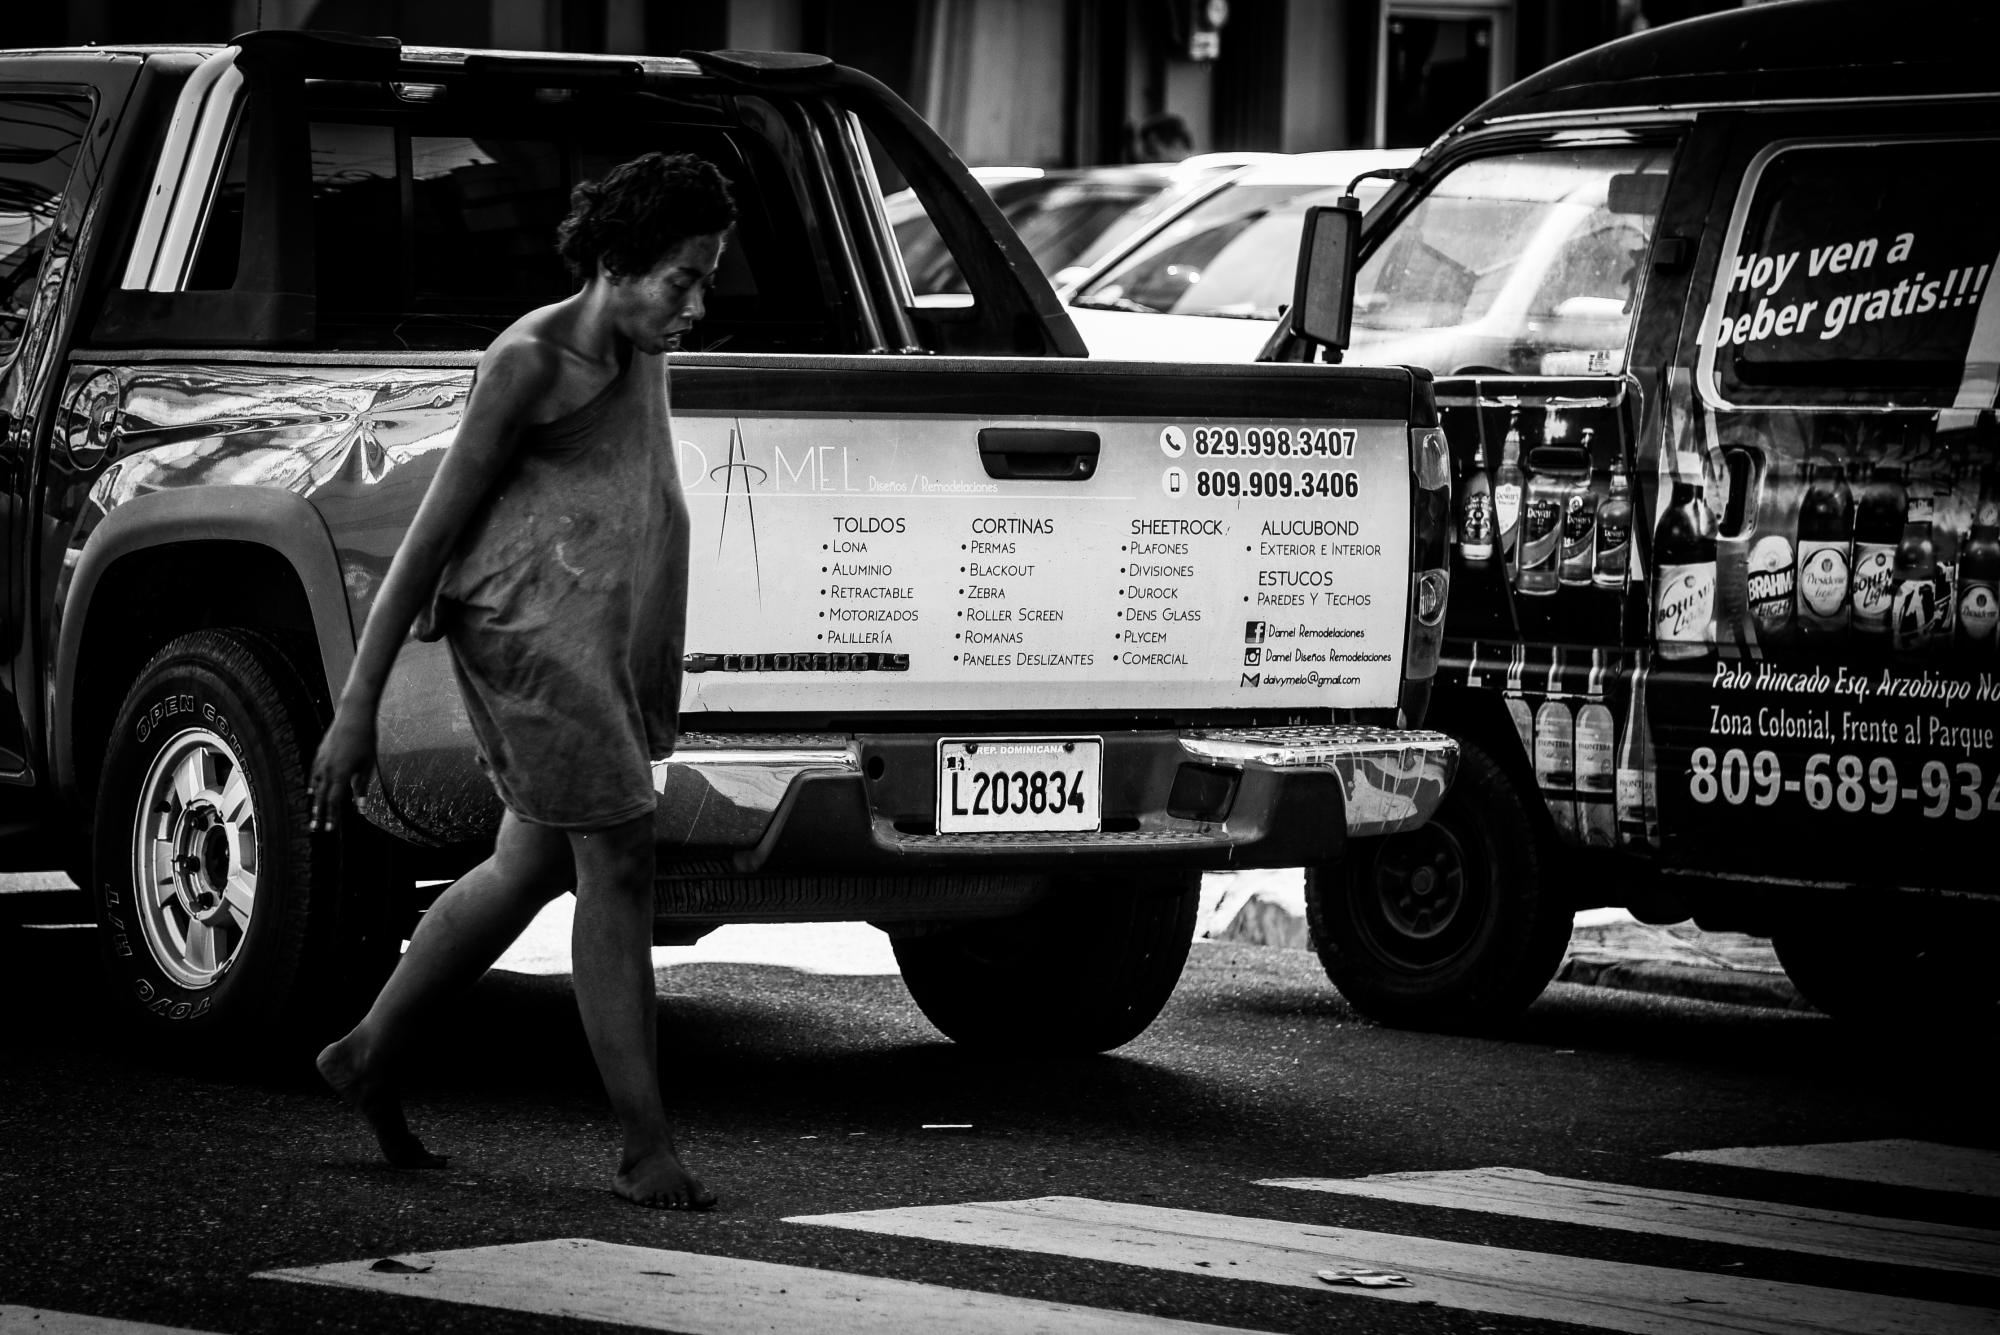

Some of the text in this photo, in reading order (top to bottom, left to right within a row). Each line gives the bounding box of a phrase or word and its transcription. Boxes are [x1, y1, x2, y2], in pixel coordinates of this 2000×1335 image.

[1728, 231, 1914, 296] Hoy ven a
[1820, 264, 1989, 340] gratis!!!
[1195, 429, 1357, 456] 829.998.3407
[869, 476, 907, 492] Diseños
[921, 476, 998, 493] Remodelaciones
[1198, 472, 1358, 497] 809.909.3406
[833, 517, 905, 533] TOLDOS
[972, 518, 1053, 534] CORTINAS
[1132, 520, 1222, 535] SHEETROCK
[1262, 521, 1358, 535] ALUCUBOND
[834, 540, 867, 552] LONA
[971, 540, 1015, 553] PERMAS
[1131, 541, 1188, 554] PLAFONES
[1261, 542, 1381, 555] EXTERIOR E INTERIOR
[832, 563, 892, 575] ALUMINIO
[970, 563, 1035, 576] BLACKOUT
[1130, 564, 1193, 576] DIVISIONES
[1259, 571, 1332, 586] ESTUCOS
[831, 585, 913, 598] RETRACTABLE
[968, 586, 1005, 598] ZEBRA
[1128, 586, 1177, 598] DUROCK
[1258, 592, 1370, 605] PAREDES Y TECHOS
[830, 608, 918, 621] MOTORIZADOS
[967, 608, 1063, 621] ROLLER SCREEN
[1126, 608, 1200, 621] DENS GLASS
[828, 630, 892, 643] PALILLERÍA
[965, 630, 1023, 643] ROMANAS
[1124, 630, 1166, 643] PLYCEM
[1299, 624, 1364, 638] Remodelaciones
[963, 653, 1093, 665] PANELES DESLIZANTES
[1123, 652, 1188, 664] COMERCIAL
[1295, 648, 1325, 662] Diseños
[1330, 648, 1391, 661] Remodelaciones
[723, 654, 868, 671] COLORADO
[1263, 671, 1360, 687] daivymelo@gmail.com
[1712, 661, 1751, 690] Palo
[1755, 662, 1829, 694] Hincado
[1834, 666, 1871, 702] Esq.
[1876, 668, 1971, 708] Arzobispo
[136, 695, 194, 743] OPEN
[1710, 705, 1993, 757] Zona Colonial, Frente al Parque
[977, 746, 1065, 754] REP. DOMINICANA
[951, 770, 1085, 815] L203834
